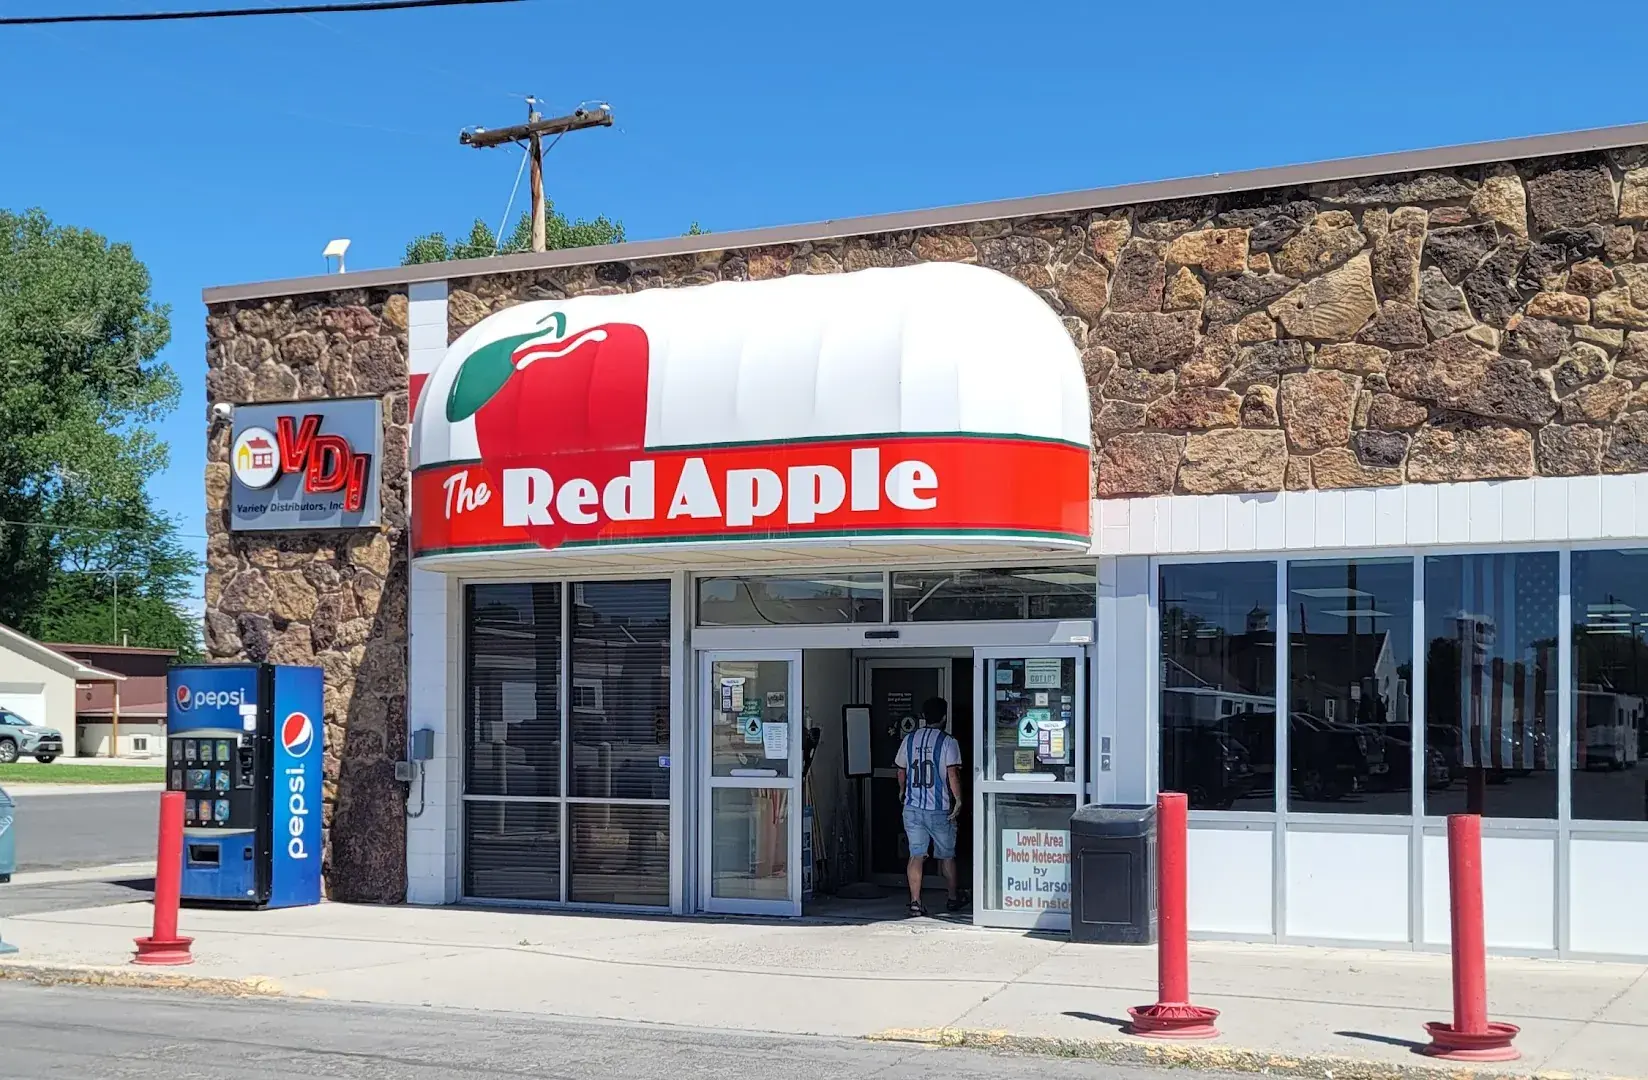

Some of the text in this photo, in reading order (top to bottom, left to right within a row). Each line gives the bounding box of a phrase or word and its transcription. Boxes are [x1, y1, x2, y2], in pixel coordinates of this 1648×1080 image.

[276, 414, 371, 512] VDI
[443, 447, 939, 527] The Red Apple
[236, 504, 268, 514] Variety
[270, 501, 326, 512] Distributors,
[194, 687, 245, 710] pepsi
[911, 758, 935, 789] 10
[286, 767, 308, 860] pepsi
[1016, 832, 1064, 848] Lovell Area
[1006, 848, 1030, 863] Photo
[1033, 866, 1048, 877] by
[1007, 877, 1032, 892] Paul
[1004, 896, 1071, 909] Sold Insid
